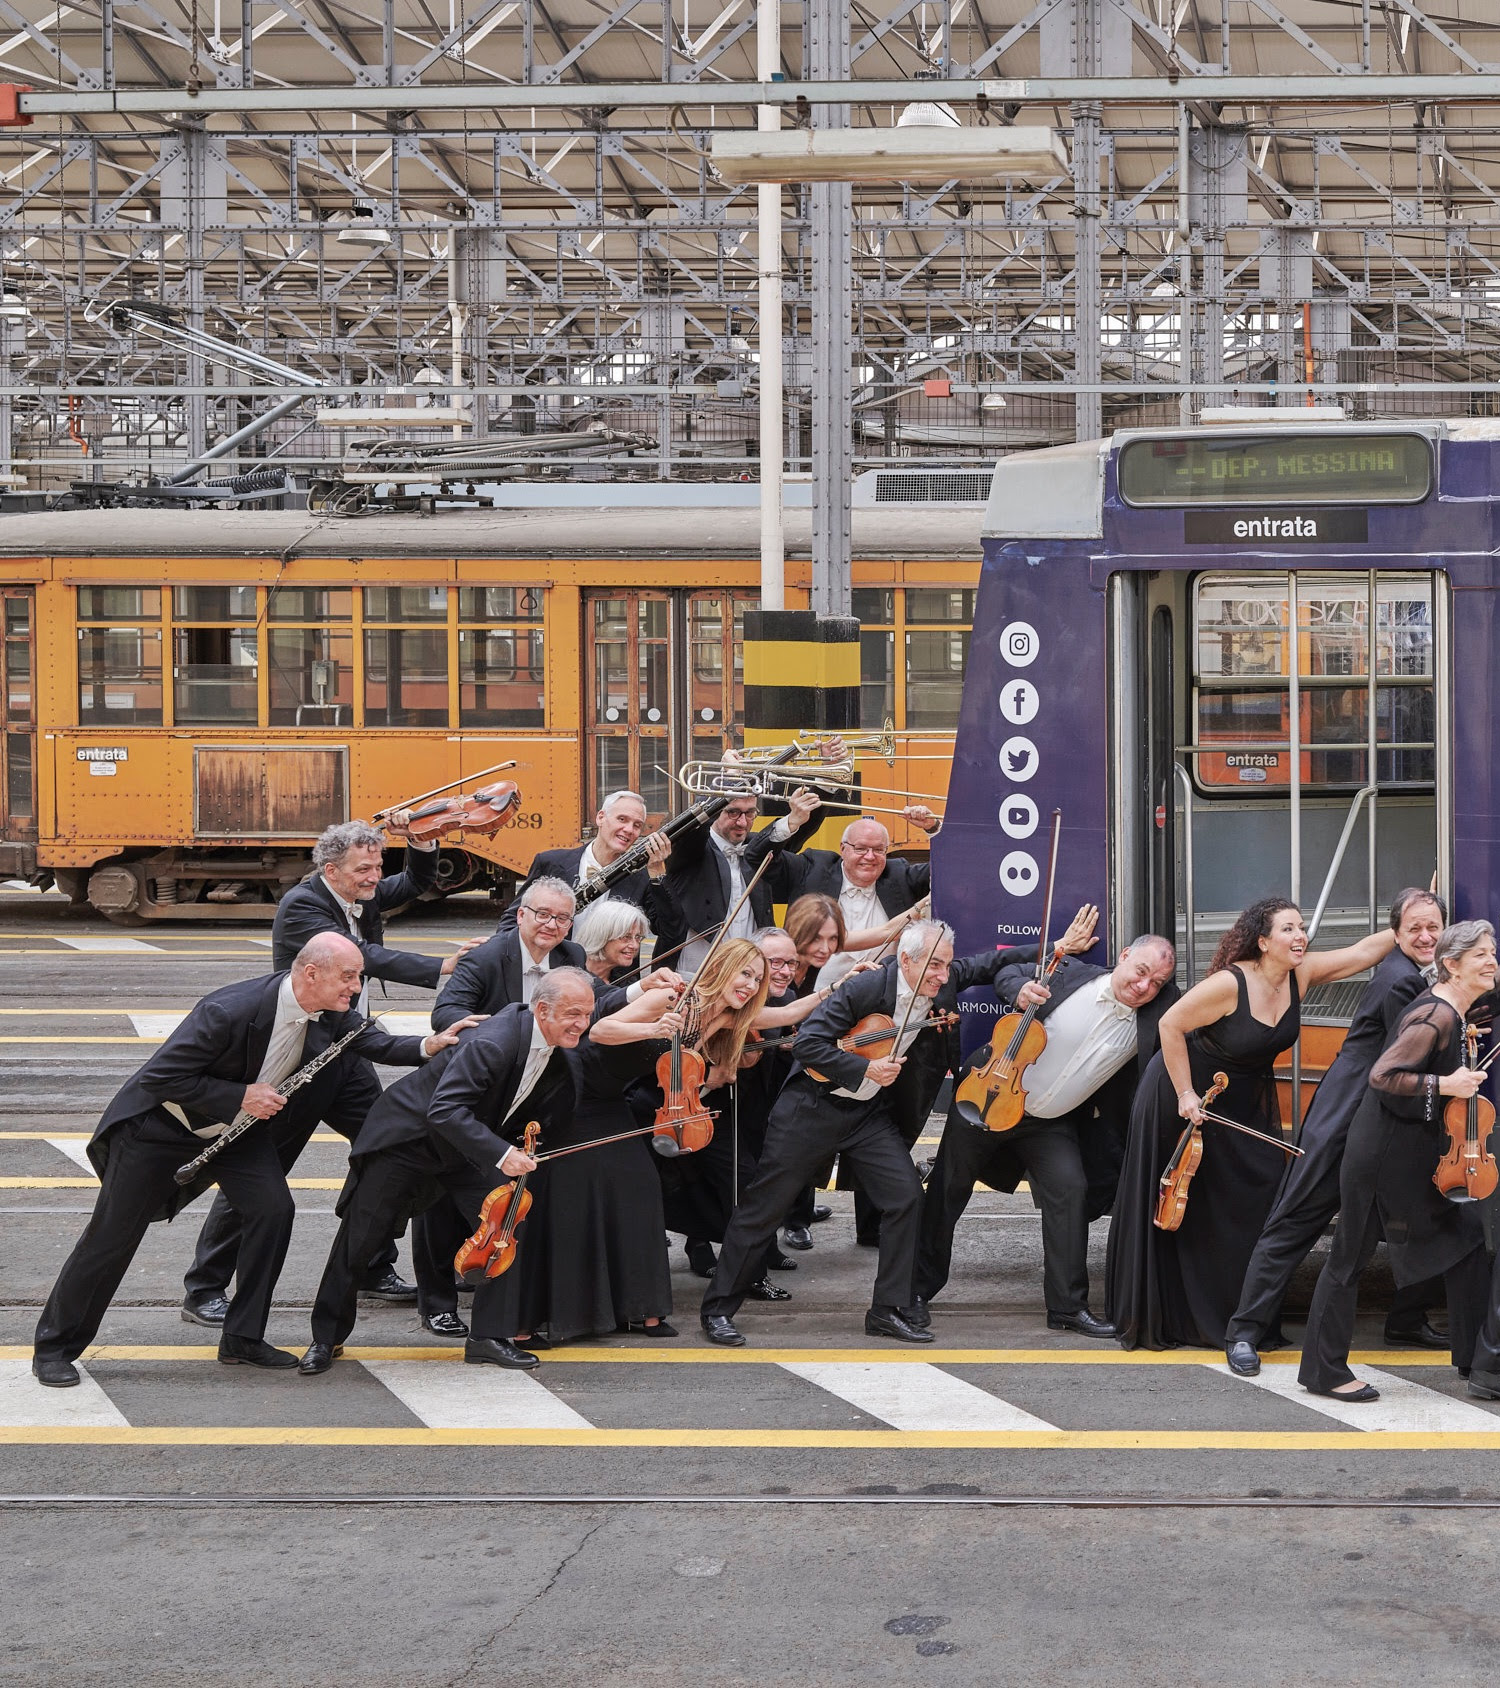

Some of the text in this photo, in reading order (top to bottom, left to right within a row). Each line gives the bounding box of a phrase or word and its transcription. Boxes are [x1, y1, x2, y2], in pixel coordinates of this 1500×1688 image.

[1278, 451, 1395, 475] MESSINA
[1233, 516, 1317, 537] entrata
[77, 747, 128, 761] entrata
[1226, 753, 1277, 766] entrata
[997, 924, 1042, 936] FOLLOW
